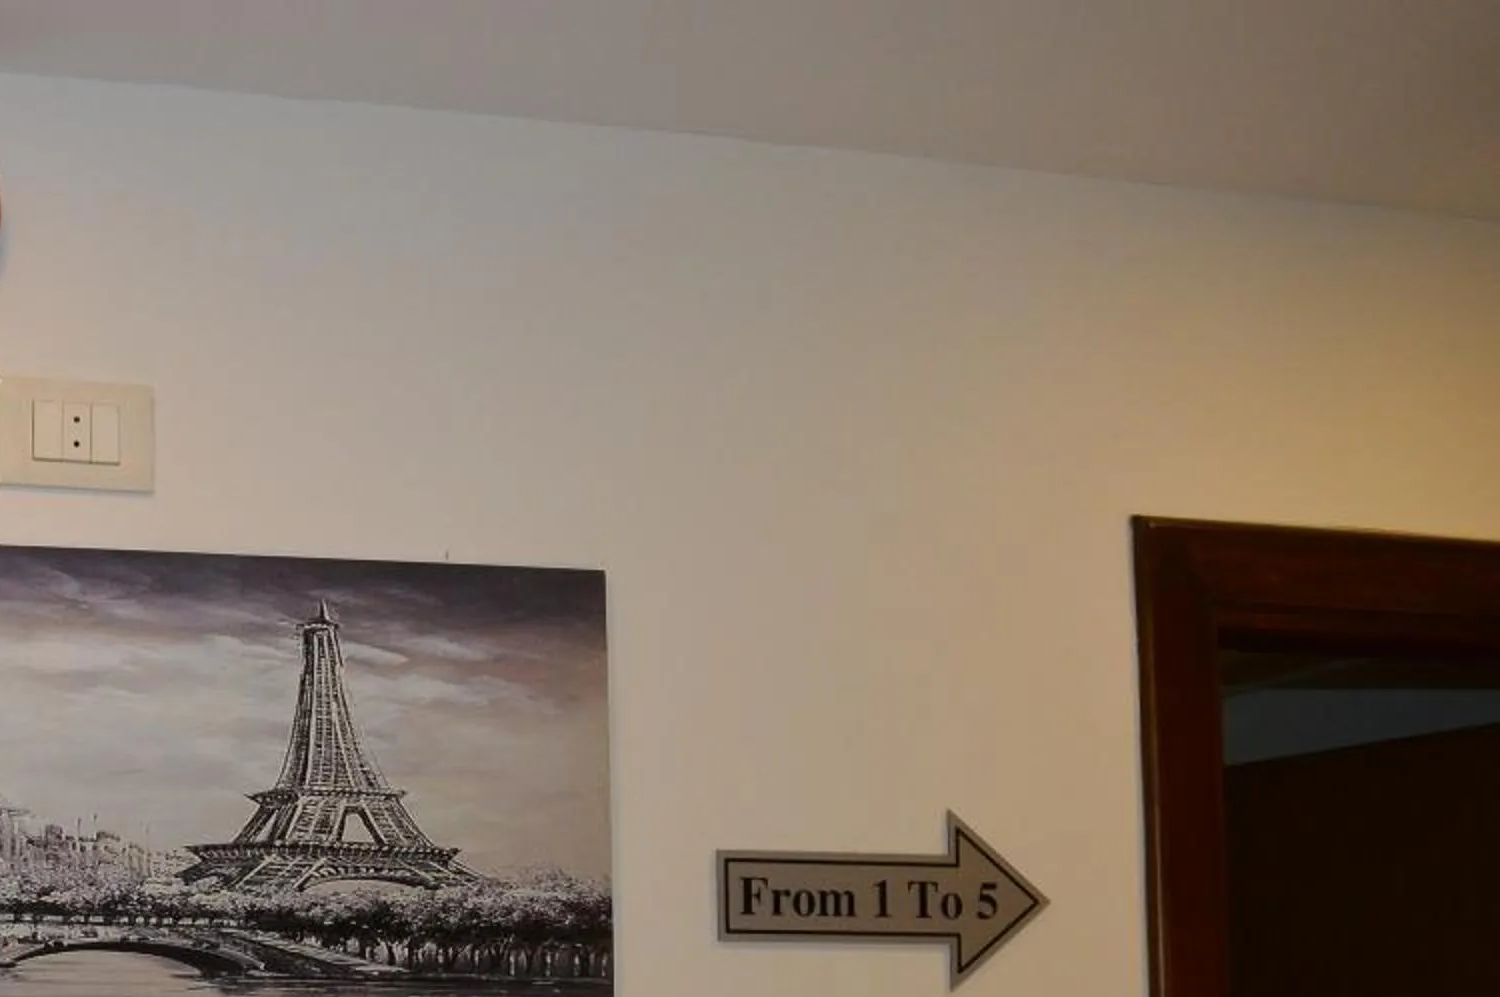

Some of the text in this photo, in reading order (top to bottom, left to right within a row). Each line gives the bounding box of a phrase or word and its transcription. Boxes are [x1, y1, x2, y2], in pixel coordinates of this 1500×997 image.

[739, 876, 999, 920] From 1 To 5
